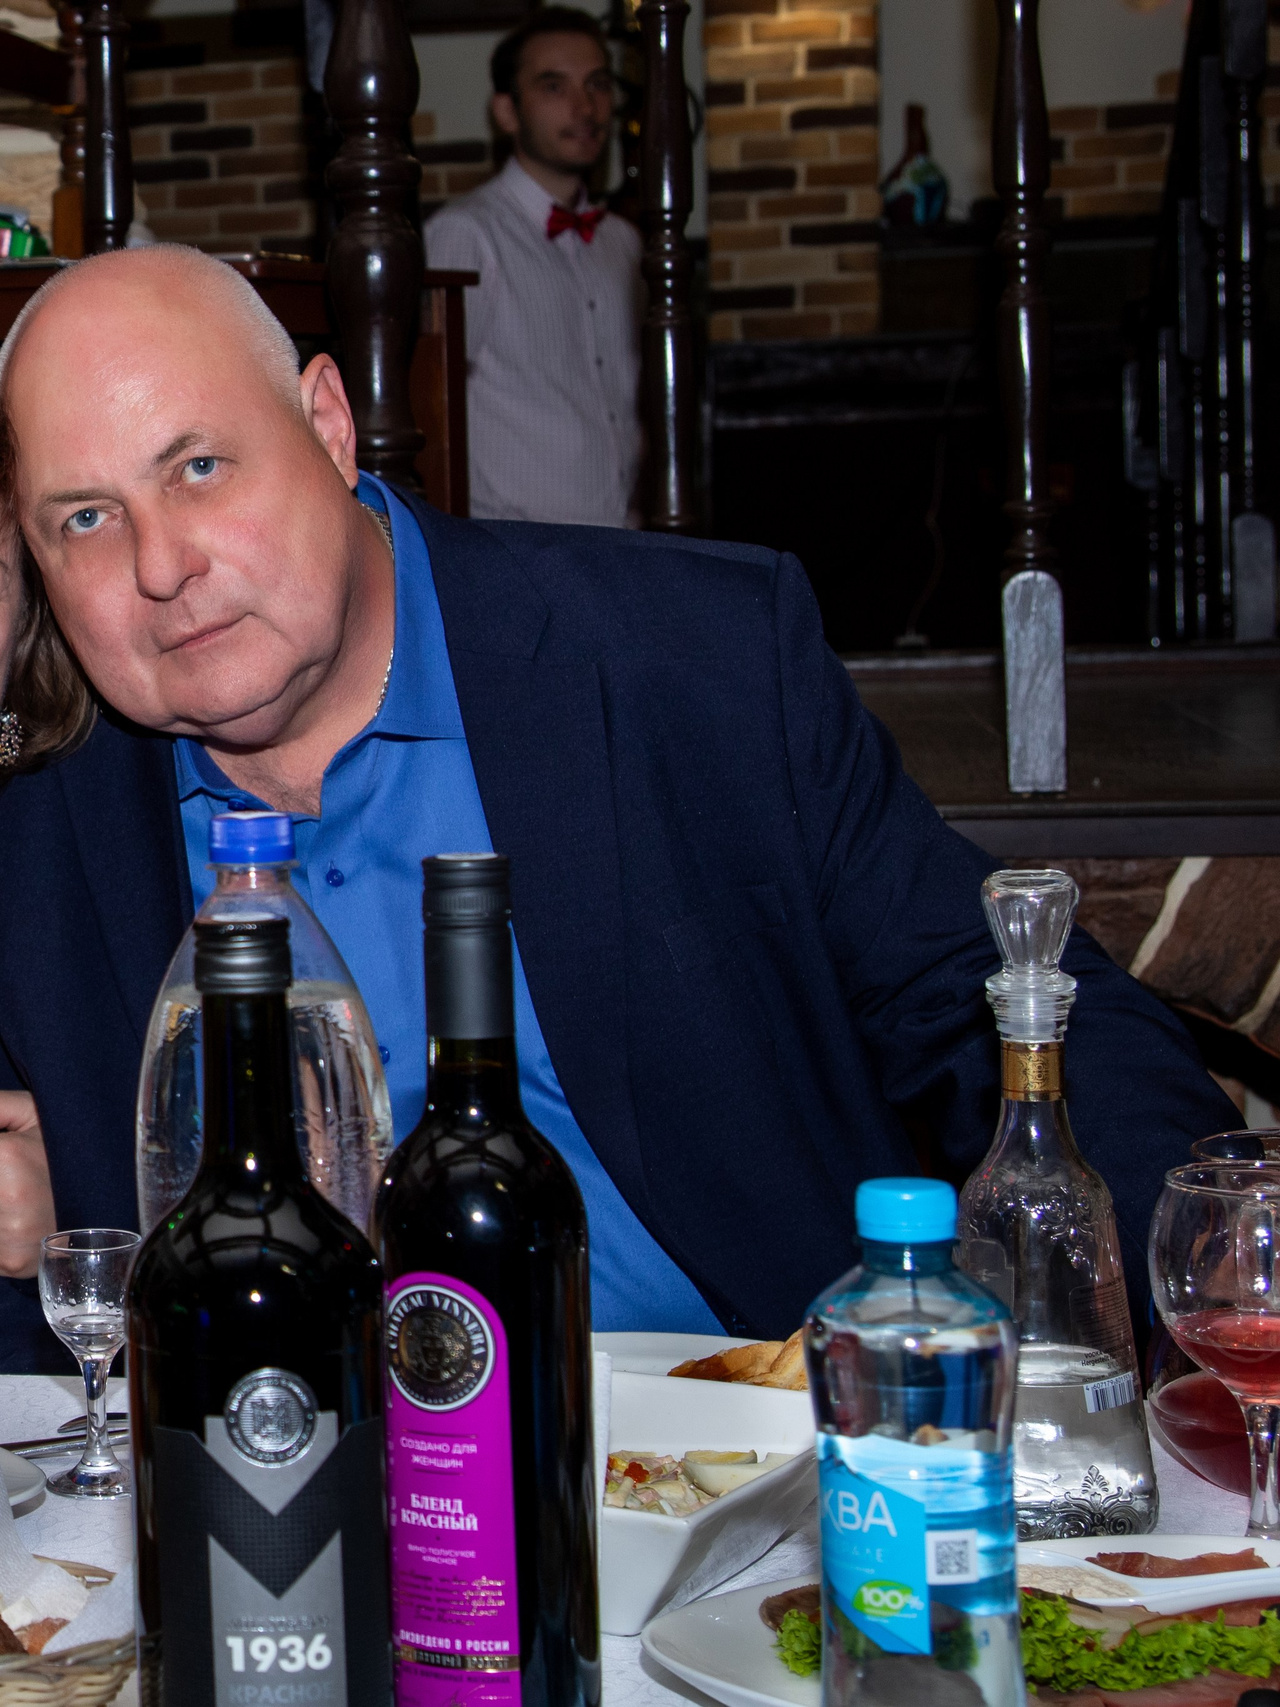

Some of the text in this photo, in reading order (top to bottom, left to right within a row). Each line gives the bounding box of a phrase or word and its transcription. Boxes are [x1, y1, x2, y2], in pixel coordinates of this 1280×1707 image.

[400, 1436, 478, 1455] СОЗДАНО ДЛЯ
[411, 1454, 464, 1469] ЖЕНЩИН
[410, 1493, 464, 1515] БЛЕНД
[821, 1488, 898, 1538] КВА
[400, 1508, 479, 1532] КРАСНЫЙ
[399, 1628, 510, 1652] ОИЗВЕДЕНО В РОССИИ
[225, 1632, 333, 1673] 1936
